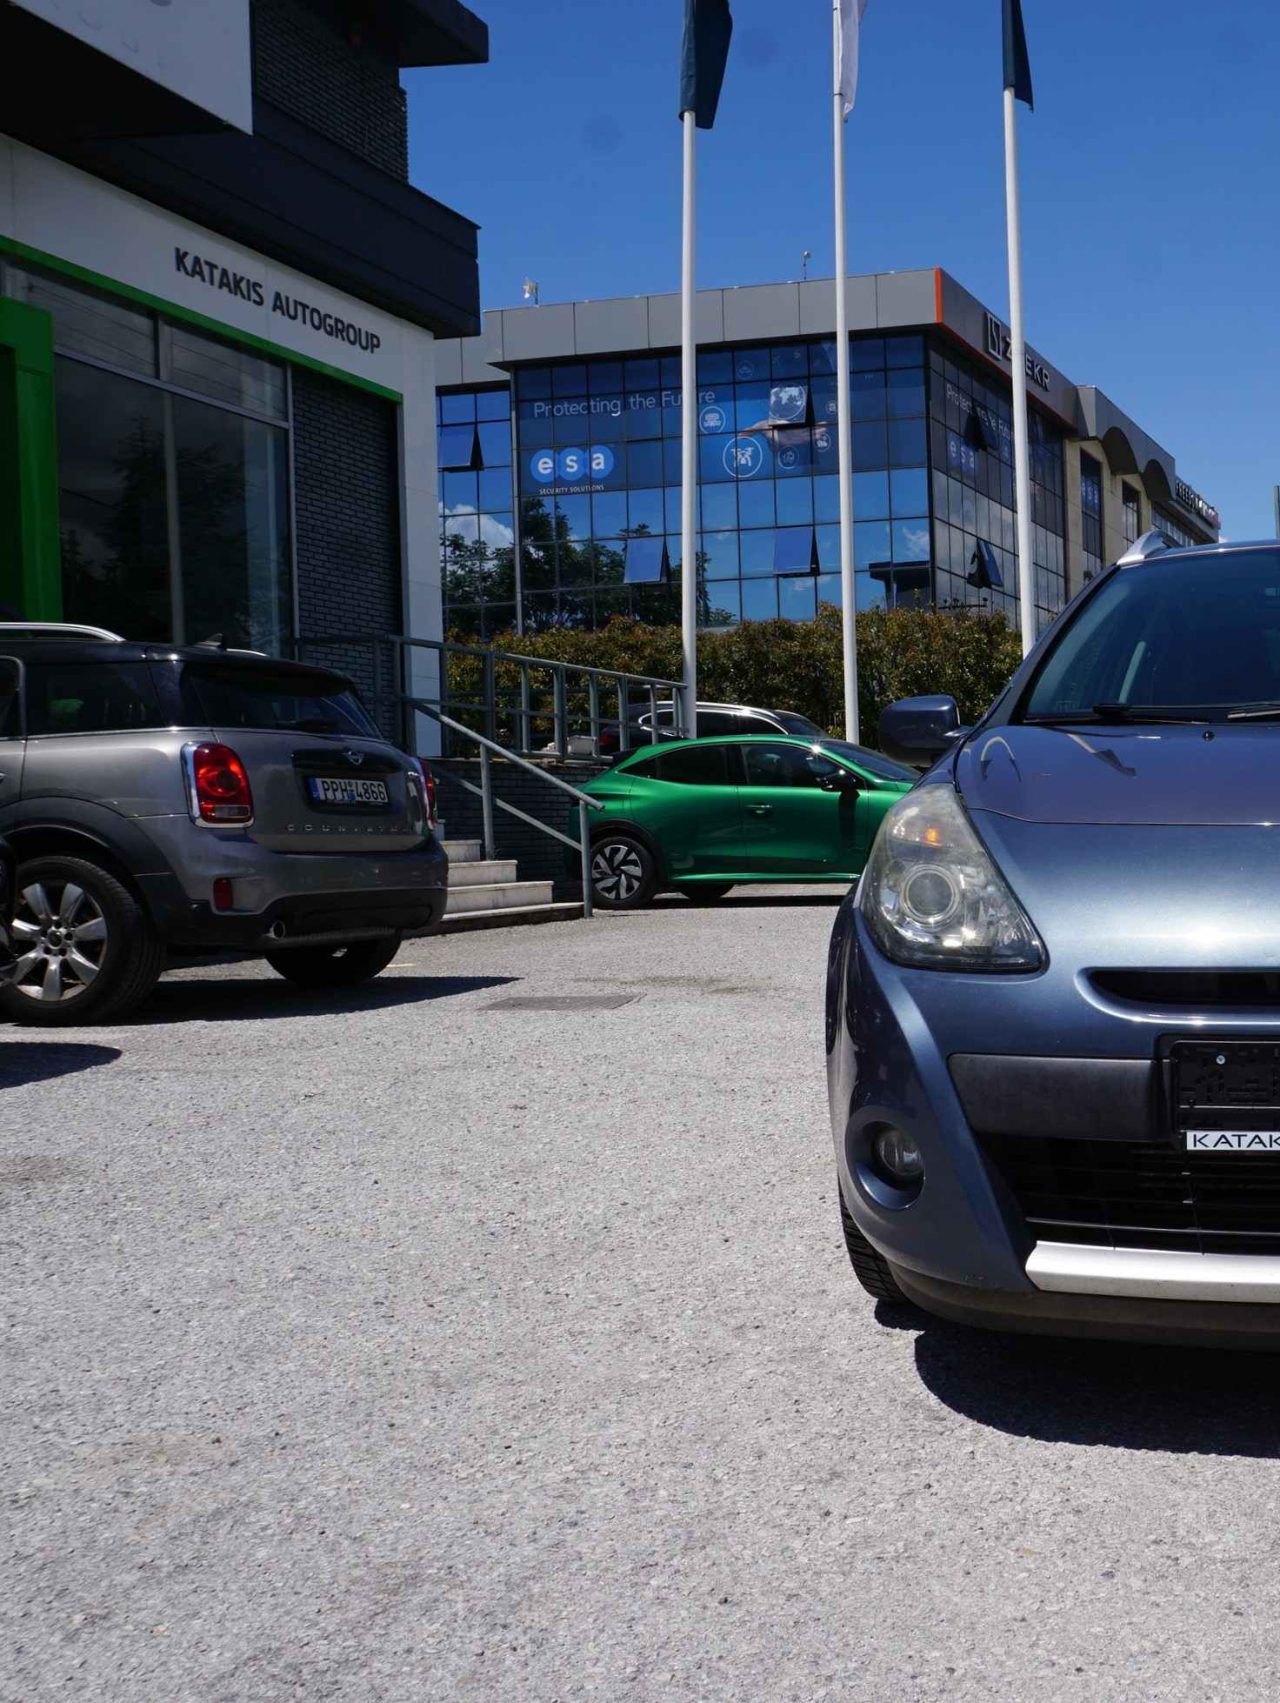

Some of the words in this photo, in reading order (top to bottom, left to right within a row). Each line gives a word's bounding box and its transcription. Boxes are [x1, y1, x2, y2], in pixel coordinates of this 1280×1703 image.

[175, 247, 264, 306] KATAKIS
[272, 291, 380, 353] AUTOGROUP
[1006, 336, 1050, 390] ZEKR
[534, 399, 621, 417] Protecting
[630, 393, 656, 409] the
[661, 391, 715, 407] Fure
[537, 452, 606, 475] esa
[539, 486, 569, 495] SECURITY
[569, 484, 605, 493] SOLUTIONS
